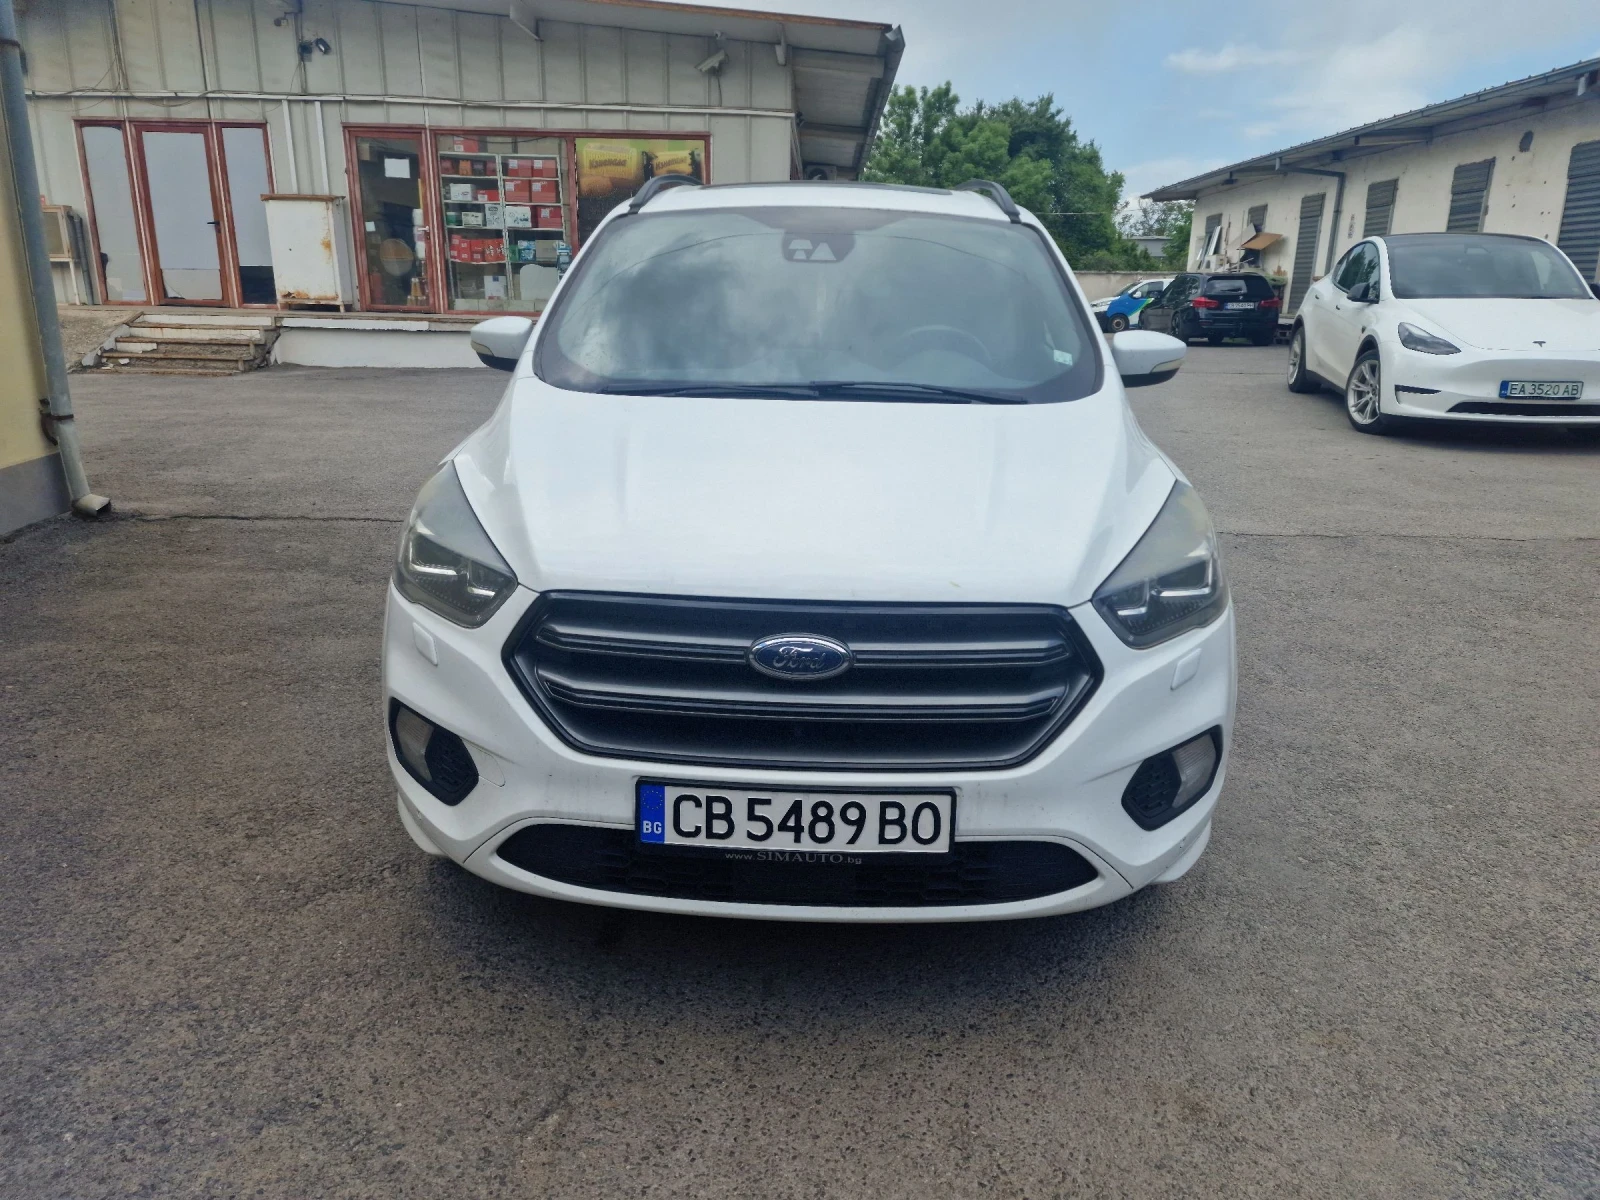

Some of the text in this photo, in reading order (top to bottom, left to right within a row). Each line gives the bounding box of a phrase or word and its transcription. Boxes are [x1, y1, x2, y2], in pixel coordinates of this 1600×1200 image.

[1509, 384, 1580, 396] EA 3520 AB
[773, 646, 826, 669] Ford
[673, 794, 735, 841] CB
[746, 797, 867, 845] 5489
[642, 820, 662, 834] BG
[725, 851, 862, 864] www.SIMAUTO.bg
